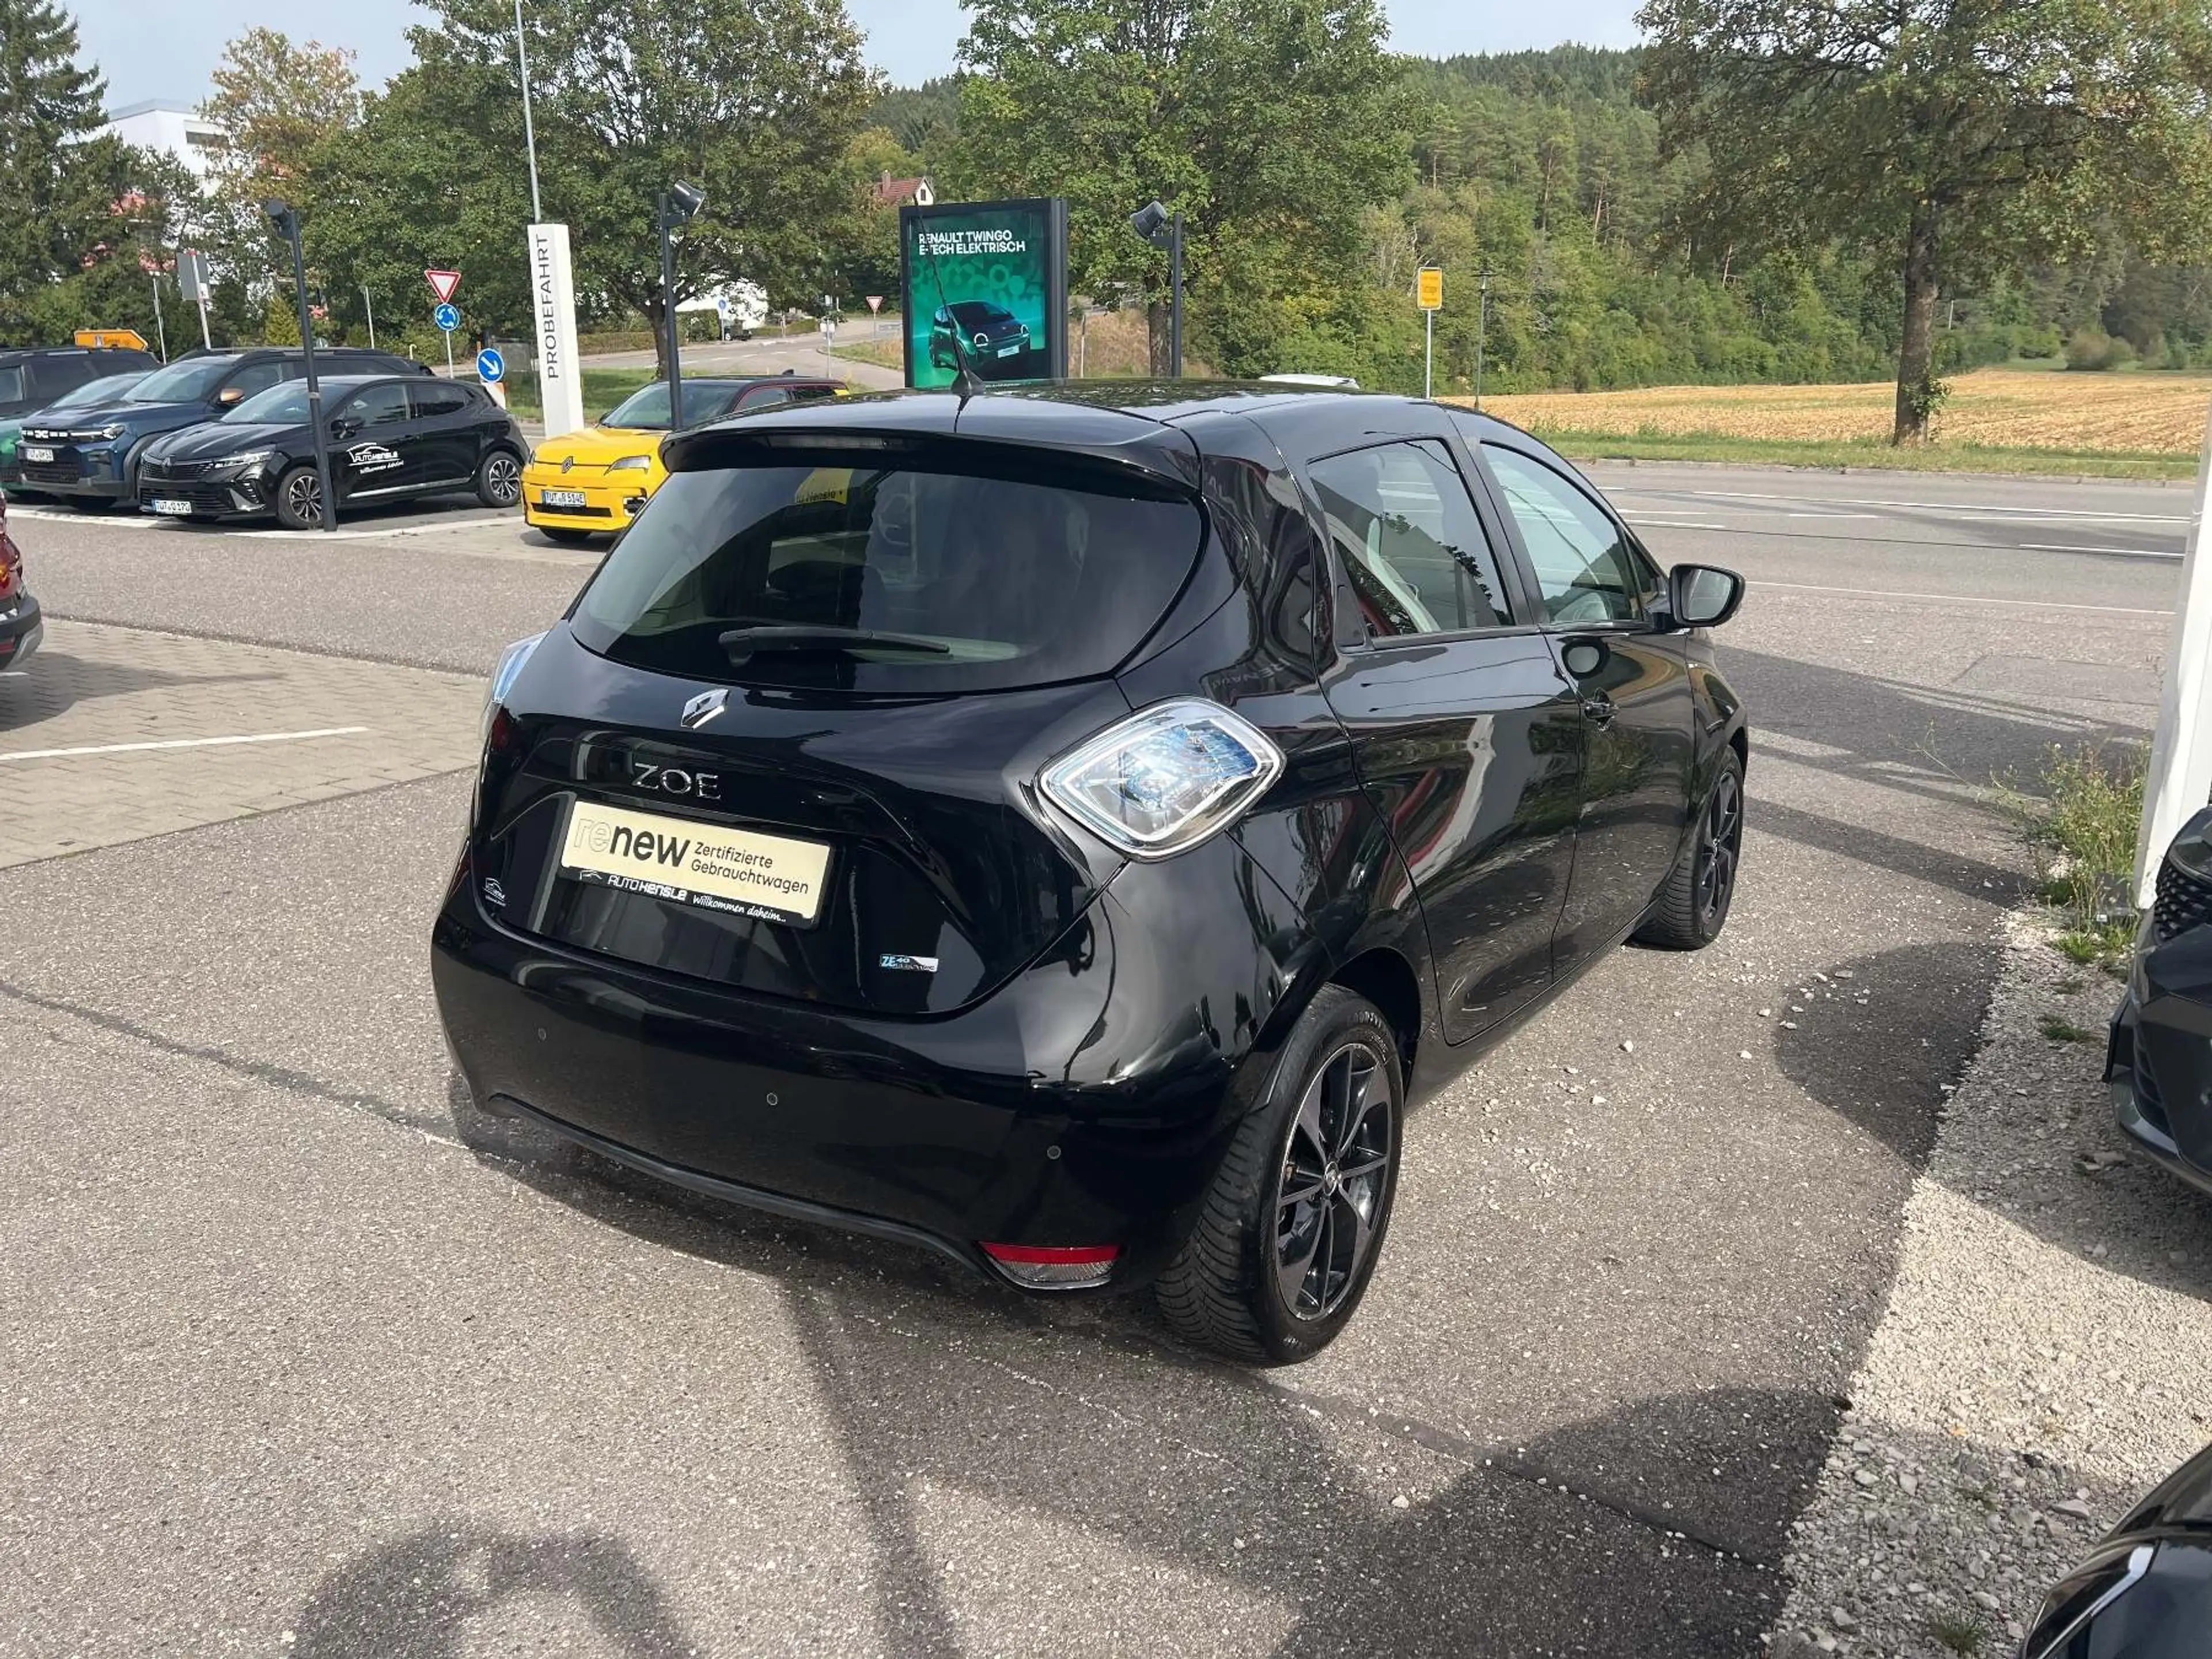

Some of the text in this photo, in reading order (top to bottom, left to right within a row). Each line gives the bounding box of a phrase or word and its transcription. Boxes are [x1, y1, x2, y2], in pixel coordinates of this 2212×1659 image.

[919, 230, 1012, 244] RENAULT TWINGO
[919, 241, 1026, 255] E-TECH ELEKTRISCH
[536, 234, 559, 378] PROBEFAHRT
[632, 762, 721, 800] ZOE
[574, 818, 773, 868] renew Zertifizierte
[691, 859, 809, 894] Gebrauchtwagen
